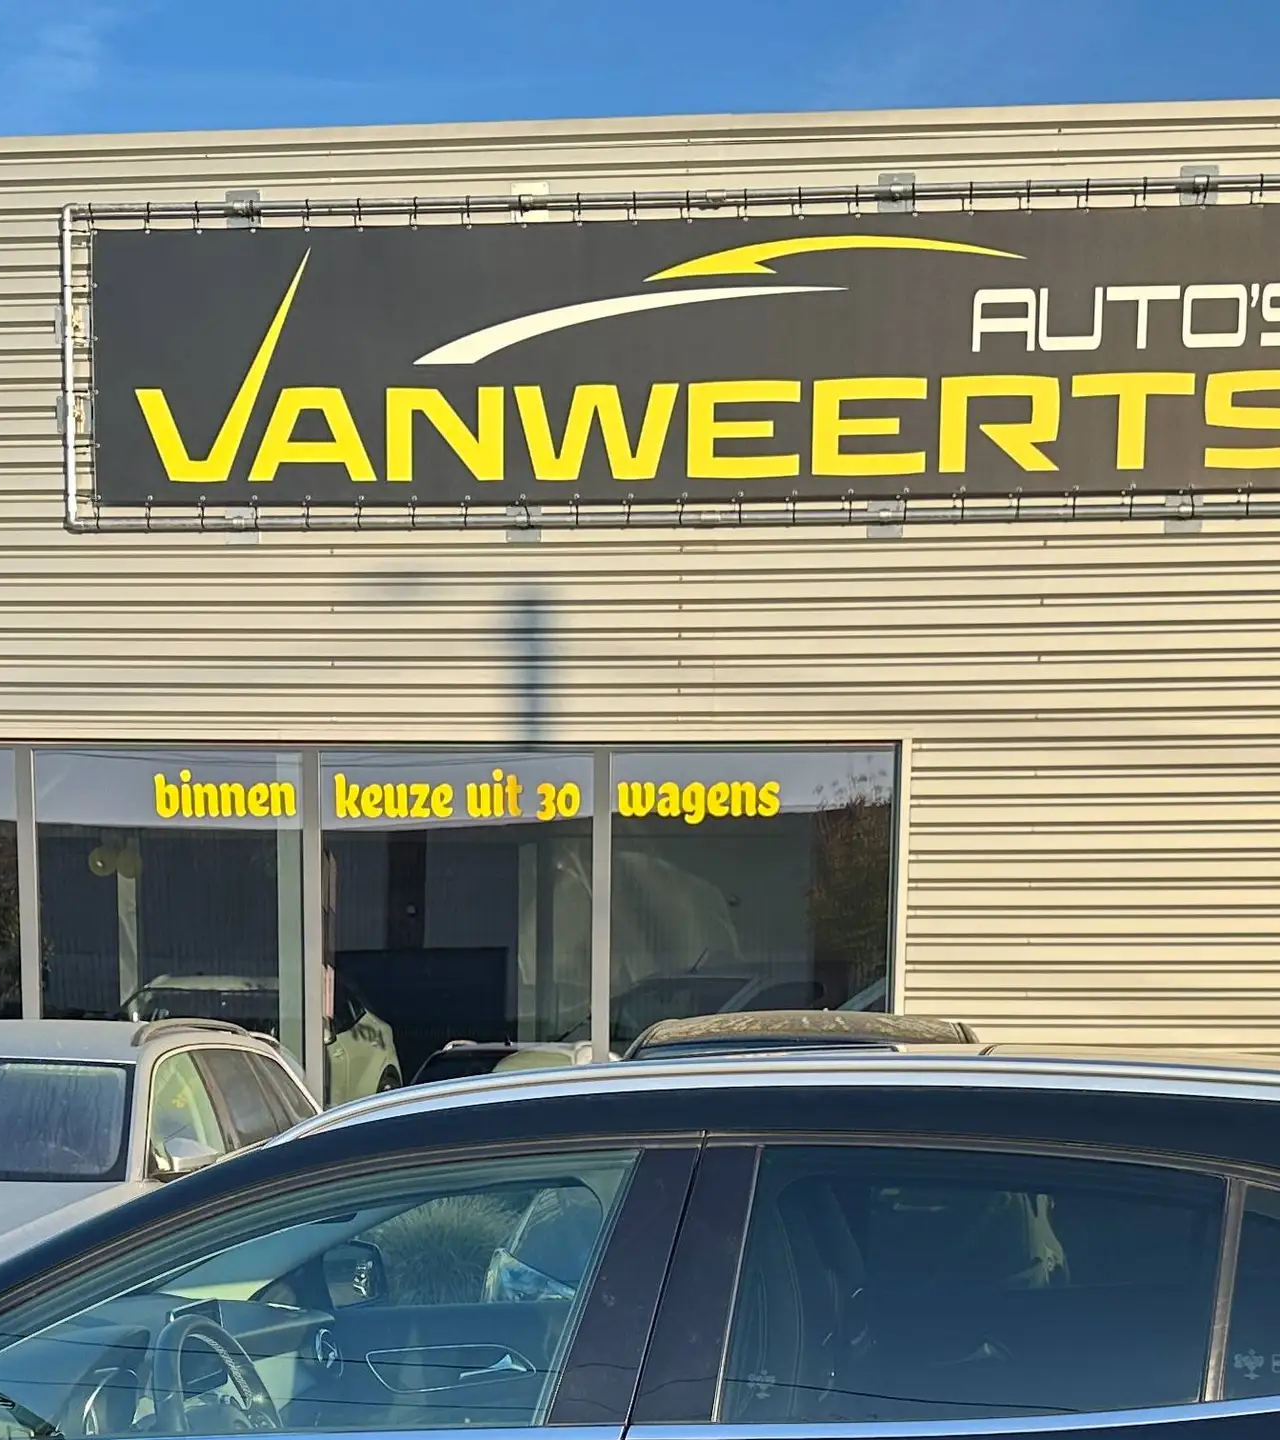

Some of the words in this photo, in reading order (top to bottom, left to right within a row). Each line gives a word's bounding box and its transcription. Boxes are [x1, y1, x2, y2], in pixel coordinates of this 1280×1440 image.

[154, 769, 297, 819] binnen
[334, 773, 454, 819] keuze
[466, 768, 523, 819] uit
[536, 782, 581, 821] 30
[616, 781, 780, 825] wagens
